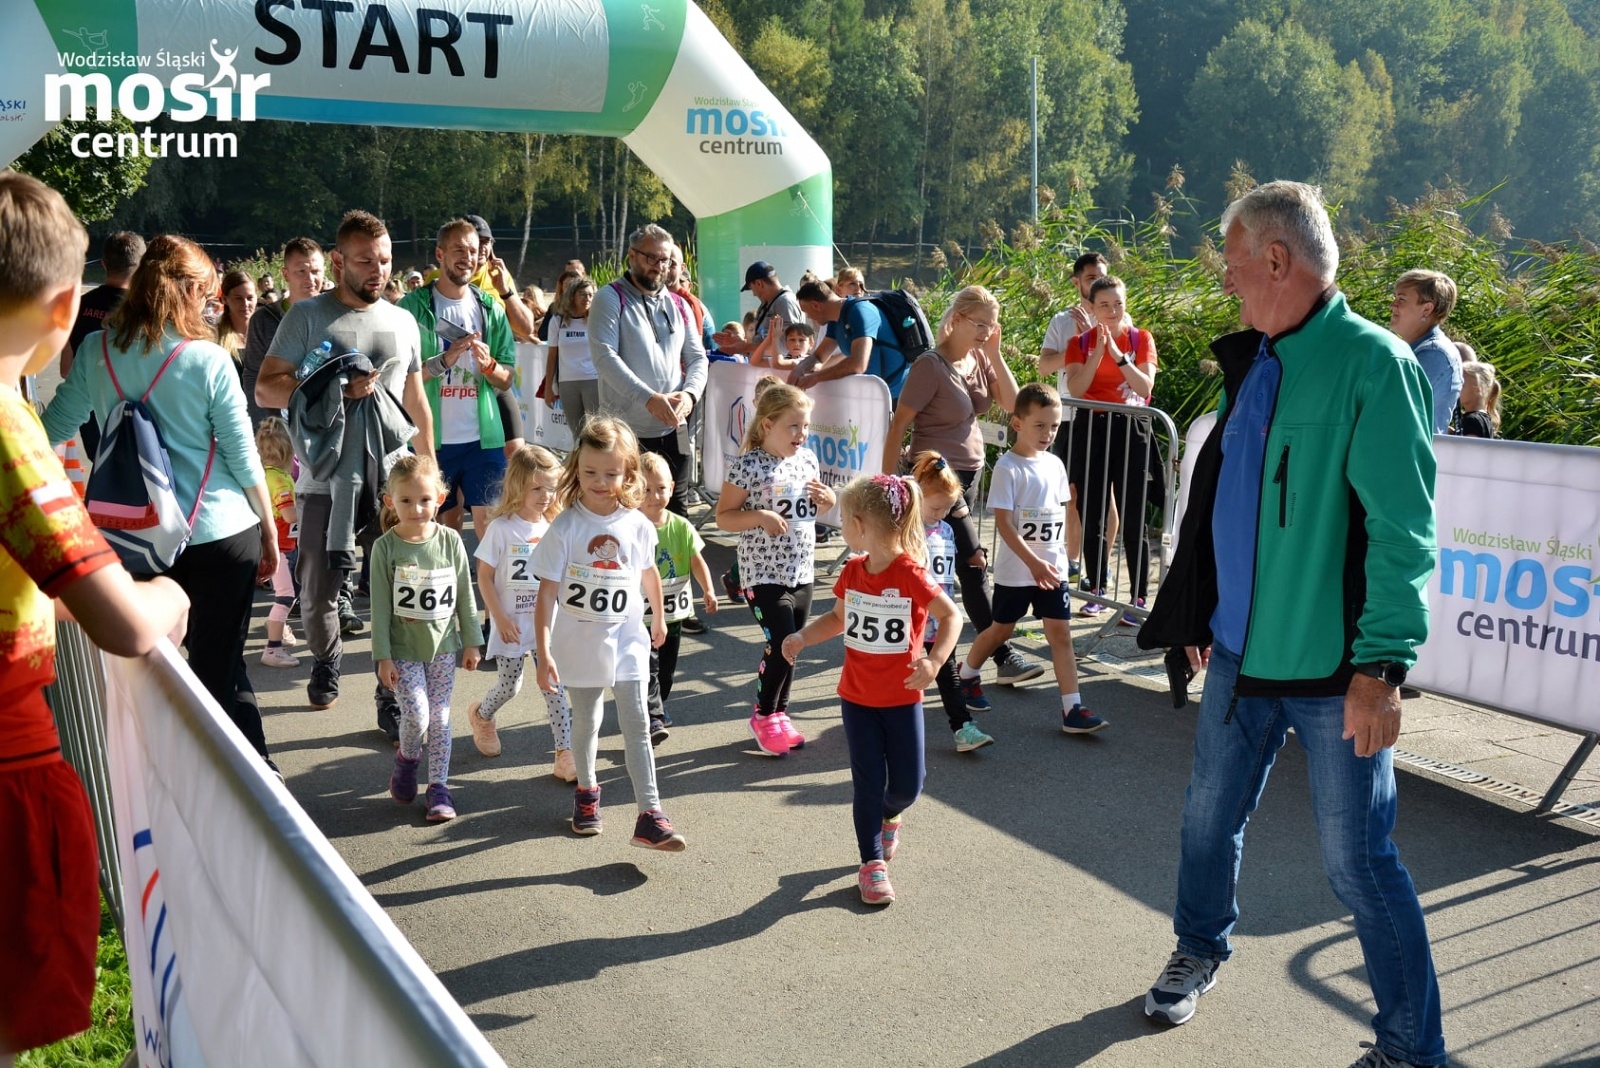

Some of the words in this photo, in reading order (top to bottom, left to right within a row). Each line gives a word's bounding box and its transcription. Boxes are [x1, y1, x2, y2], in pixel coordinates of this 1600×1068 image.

[254, 0, 514, 78] START
[699, 138, 783, 155] centrum
[776, 498, 818, 519] 265
[1022, 521, 1064, 542] 257
[1453, 527, 1541, 553] Wodzisław
[1546, 536, 1593, 561] Śląski
[932, 555, 954, 576] 67
[397, 585, 454, 611] 264
[515, 594, 537, 603] POZY
[566, 583, 628, 613] 260
[847, 611, 905, 644] 258
